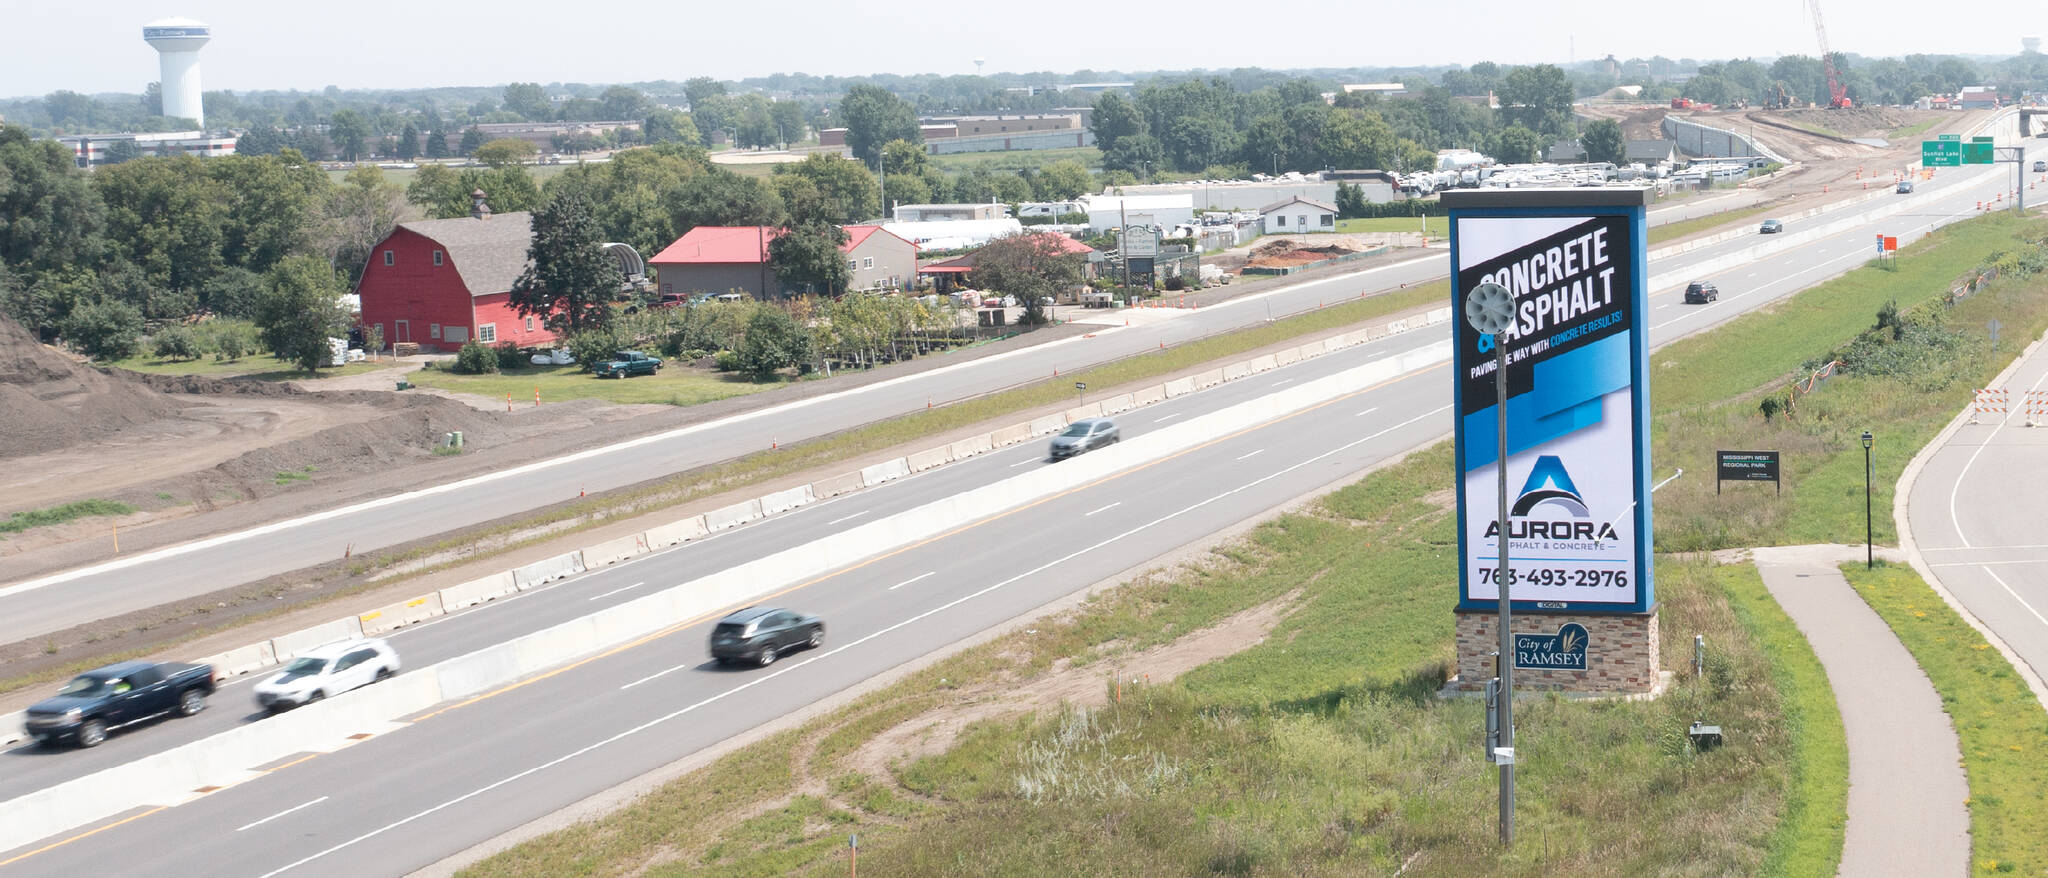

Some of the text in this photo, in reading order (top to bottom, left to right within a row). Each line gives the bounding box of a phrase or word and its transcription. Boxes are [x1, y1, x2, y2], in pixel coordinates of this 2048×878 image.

[1480, 226, 1609, 299] ONCRETE
[1503, 267, 1615, 345] ASPHALT
[1470, 359, 1498, 379] PAVING
[1512, 345, 1531, 363] WAY
[1531, 338, 1550, 356] WITH
[1550, 324, 1588, 348] CONCRETE
[1587, 309, 1623, 332] RESULTS!
[1483, 520, 1619, 541] AURORA
[1498, 541, 1606, 551] PHALT & CONCRETE
[1478, 567, 1629, 588] 763-493-2976
[1518, 637, 1556, 652] City of
[1518, 651, 1583, 665] RAMSEY
